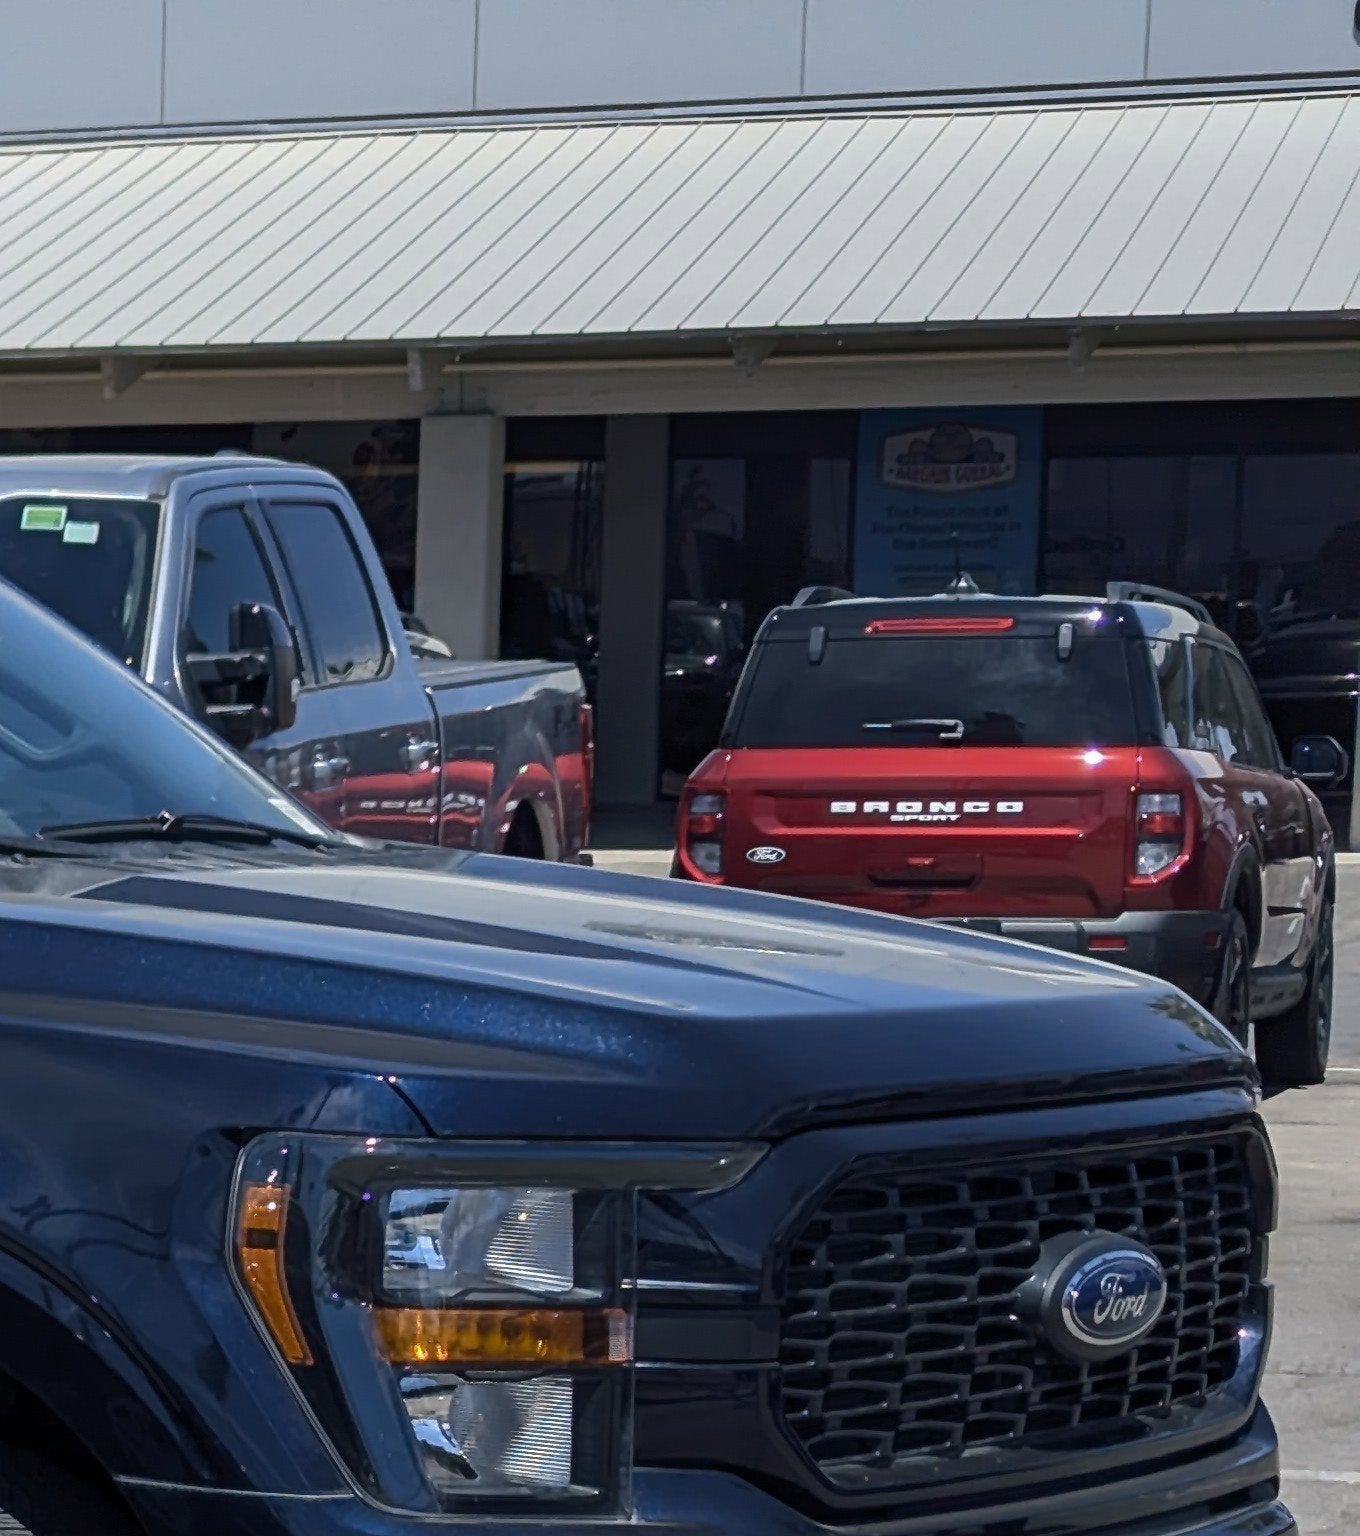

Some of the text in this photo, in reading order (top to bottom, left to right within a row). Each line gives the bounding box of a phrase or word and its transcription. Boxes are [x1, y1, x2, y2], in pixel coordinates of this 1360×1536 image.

[830, 801, 1024, 813] BRONCO
[890, 814, 960, 822] SPORT
[1093, 1272, 1149, 1325] Ford
